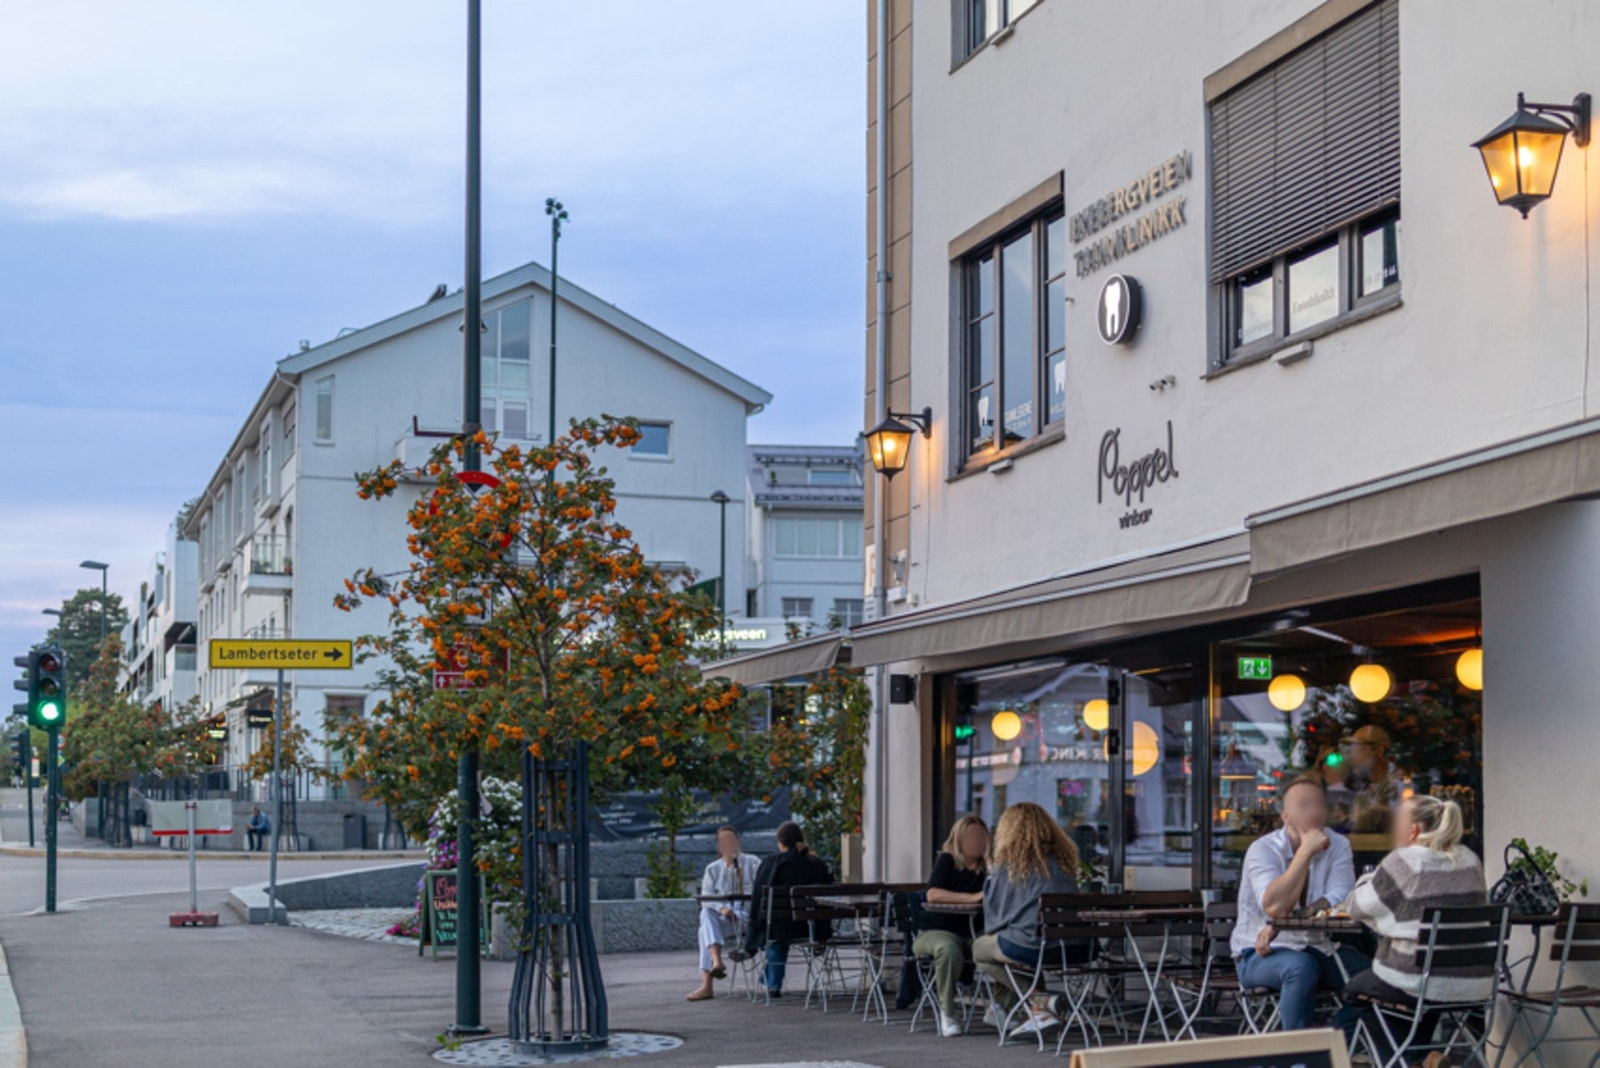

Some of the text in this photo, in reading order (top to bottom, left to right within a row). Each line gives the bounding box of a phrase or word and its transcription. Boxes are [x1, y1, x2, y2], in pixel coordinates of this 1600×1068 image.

[1074, 195, 1187, 278] TANNKLINIKK
[1098, 419, 1179, 507] Poppel
[219, 646, 318, 660] Lambertseter
